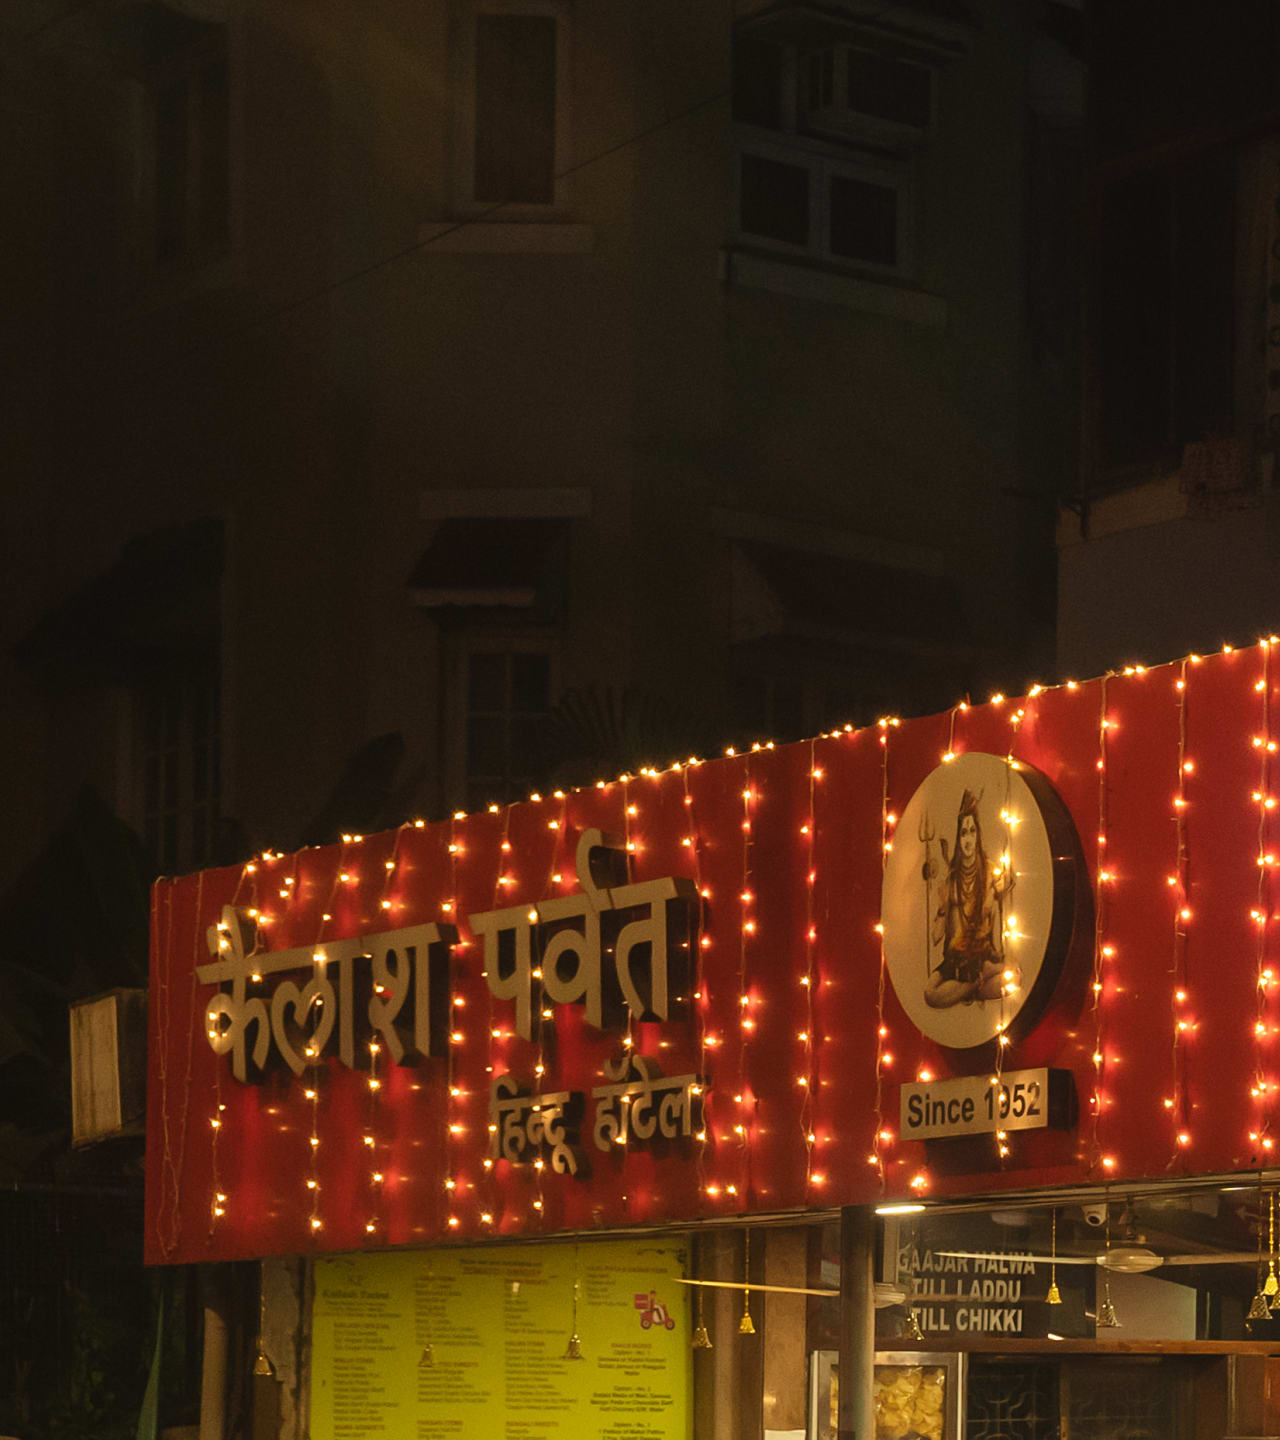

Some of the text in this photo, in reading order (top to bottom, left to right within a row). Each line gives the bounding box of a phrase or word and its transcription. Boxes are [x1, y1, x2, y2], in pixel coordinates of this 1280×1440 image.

[195, 828, 698, 1080] कैलाश पर्वत
[490, 1054, 704, 1175] हिन्दू हॉटेल
[905, 1080, 1043, 1130] Since 1952
[898, 1248, 1036, 1275] GAAJAR HALWA
[912, 1308, 1023, 1332] TILL CHIKKI
